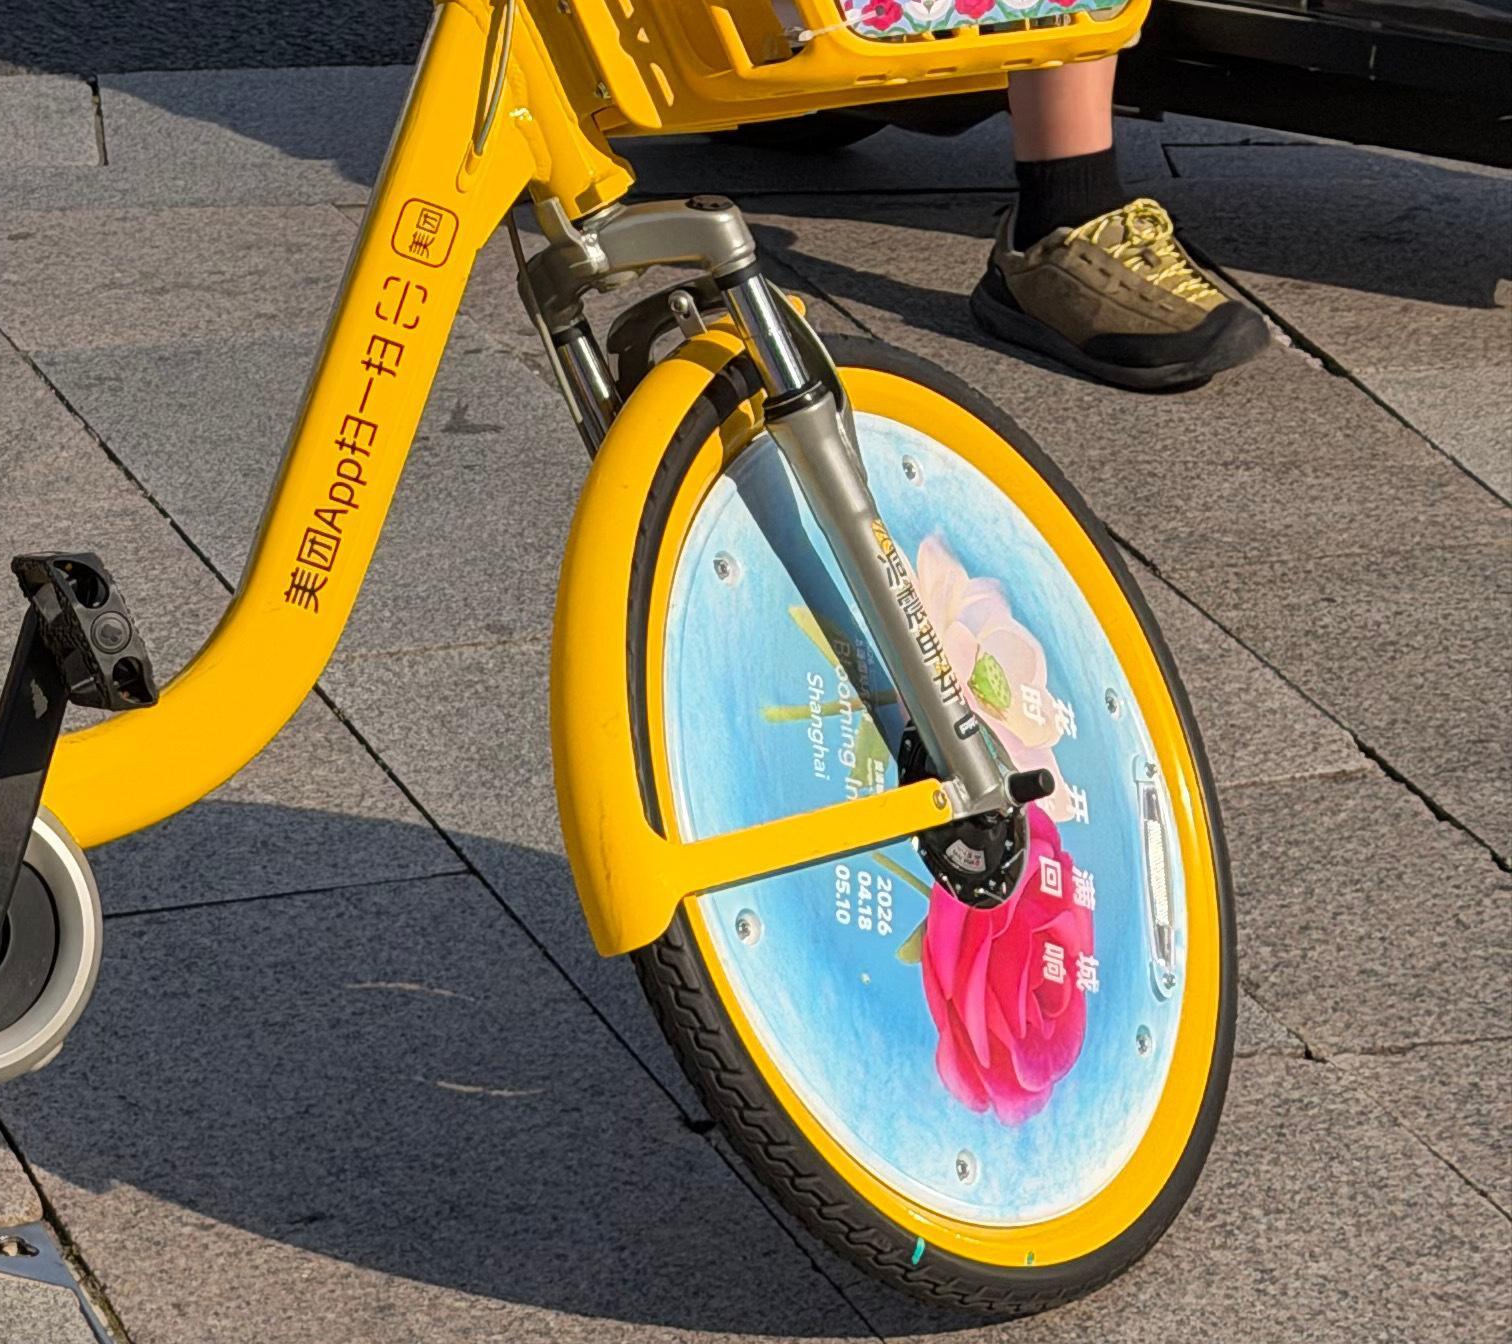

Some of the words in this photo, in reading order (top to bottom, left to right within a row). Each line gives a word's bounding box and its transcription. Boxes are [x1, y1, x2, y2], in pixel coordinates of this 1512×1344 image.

[408, 207, 444, 259] 美团
[284, 334, 405, 613] 美团App扫一扫
[807, 671, 830, 782] Shanghai
[835, 864, 851, 925] 05.10
[857, 870, 872, 931] 04.18
[877, 875, 892, 936] 2026
